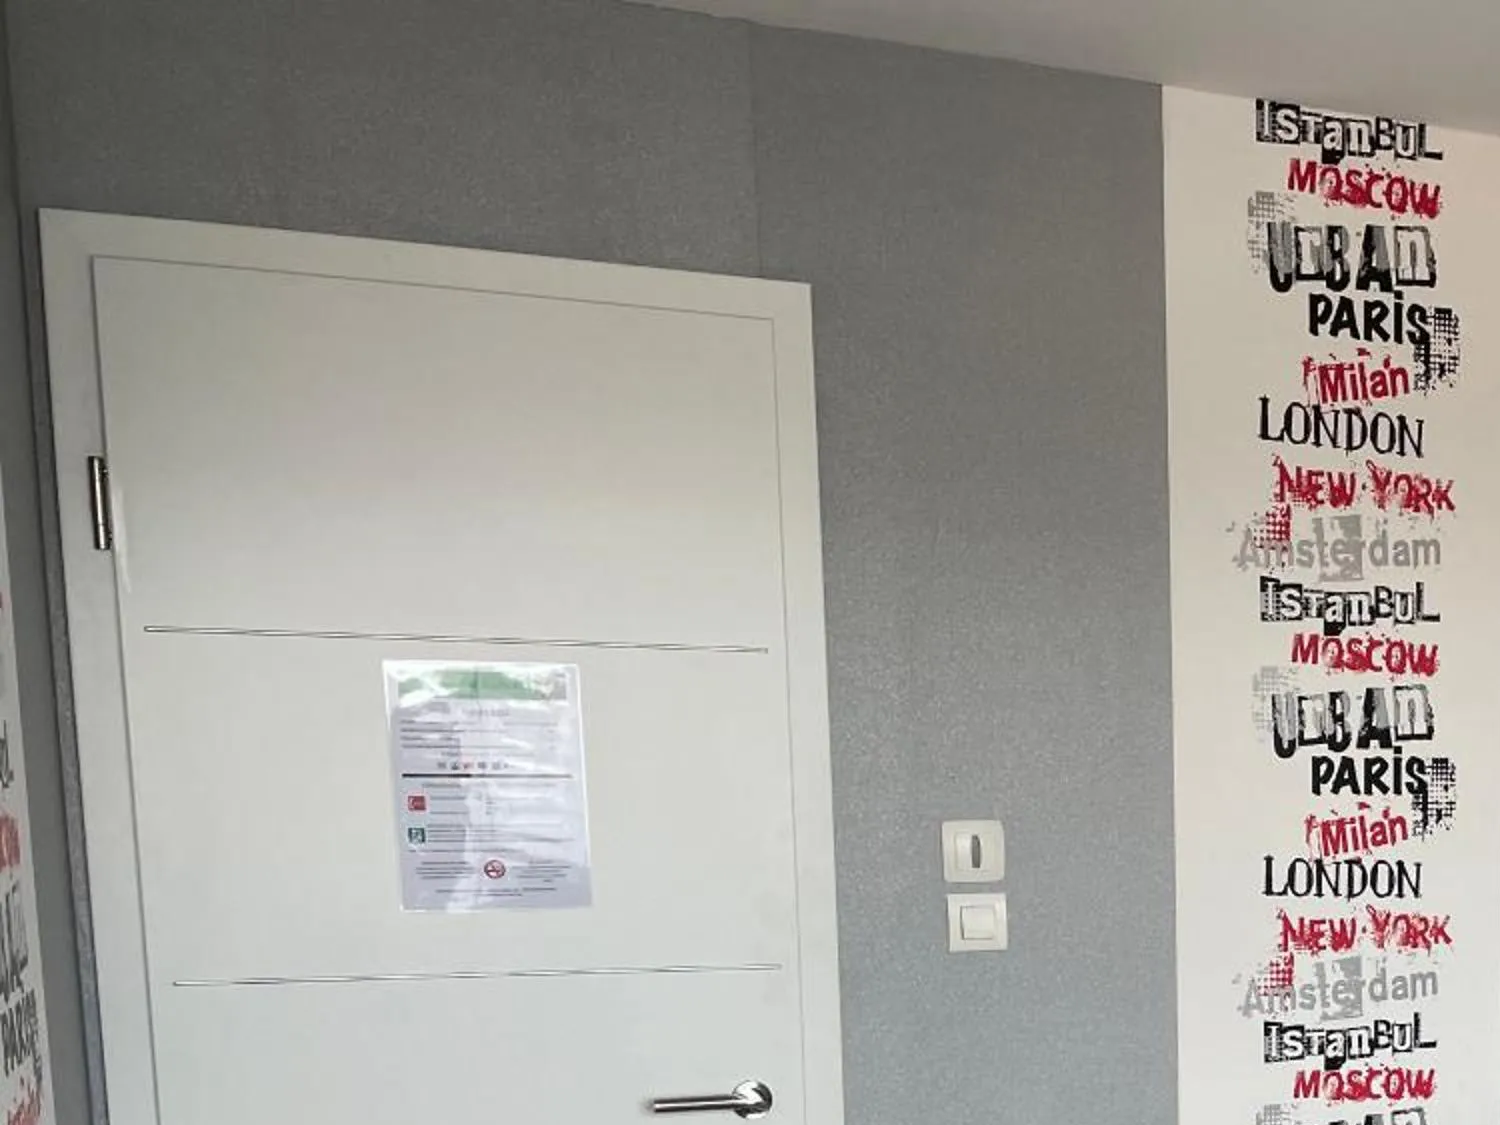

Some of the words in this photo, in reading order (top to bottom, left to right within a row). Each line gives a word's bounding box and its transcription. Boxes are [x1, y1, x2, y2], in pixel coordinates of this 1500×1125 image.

[1258, 396, 1424, 457] LONDON
[1277, 457, 1356, 507] NEW
[1367, 461, 1456, 514] YORK
[1239, 526, 1441, 571] Amsterdam
[1263, 856, 1422, 901] LONDON
[1281, 911, 1356, 953] NEW
[1367, 906, 1452, 953] YORK
[1242, 966, 1437, 1018] Amsterdam
